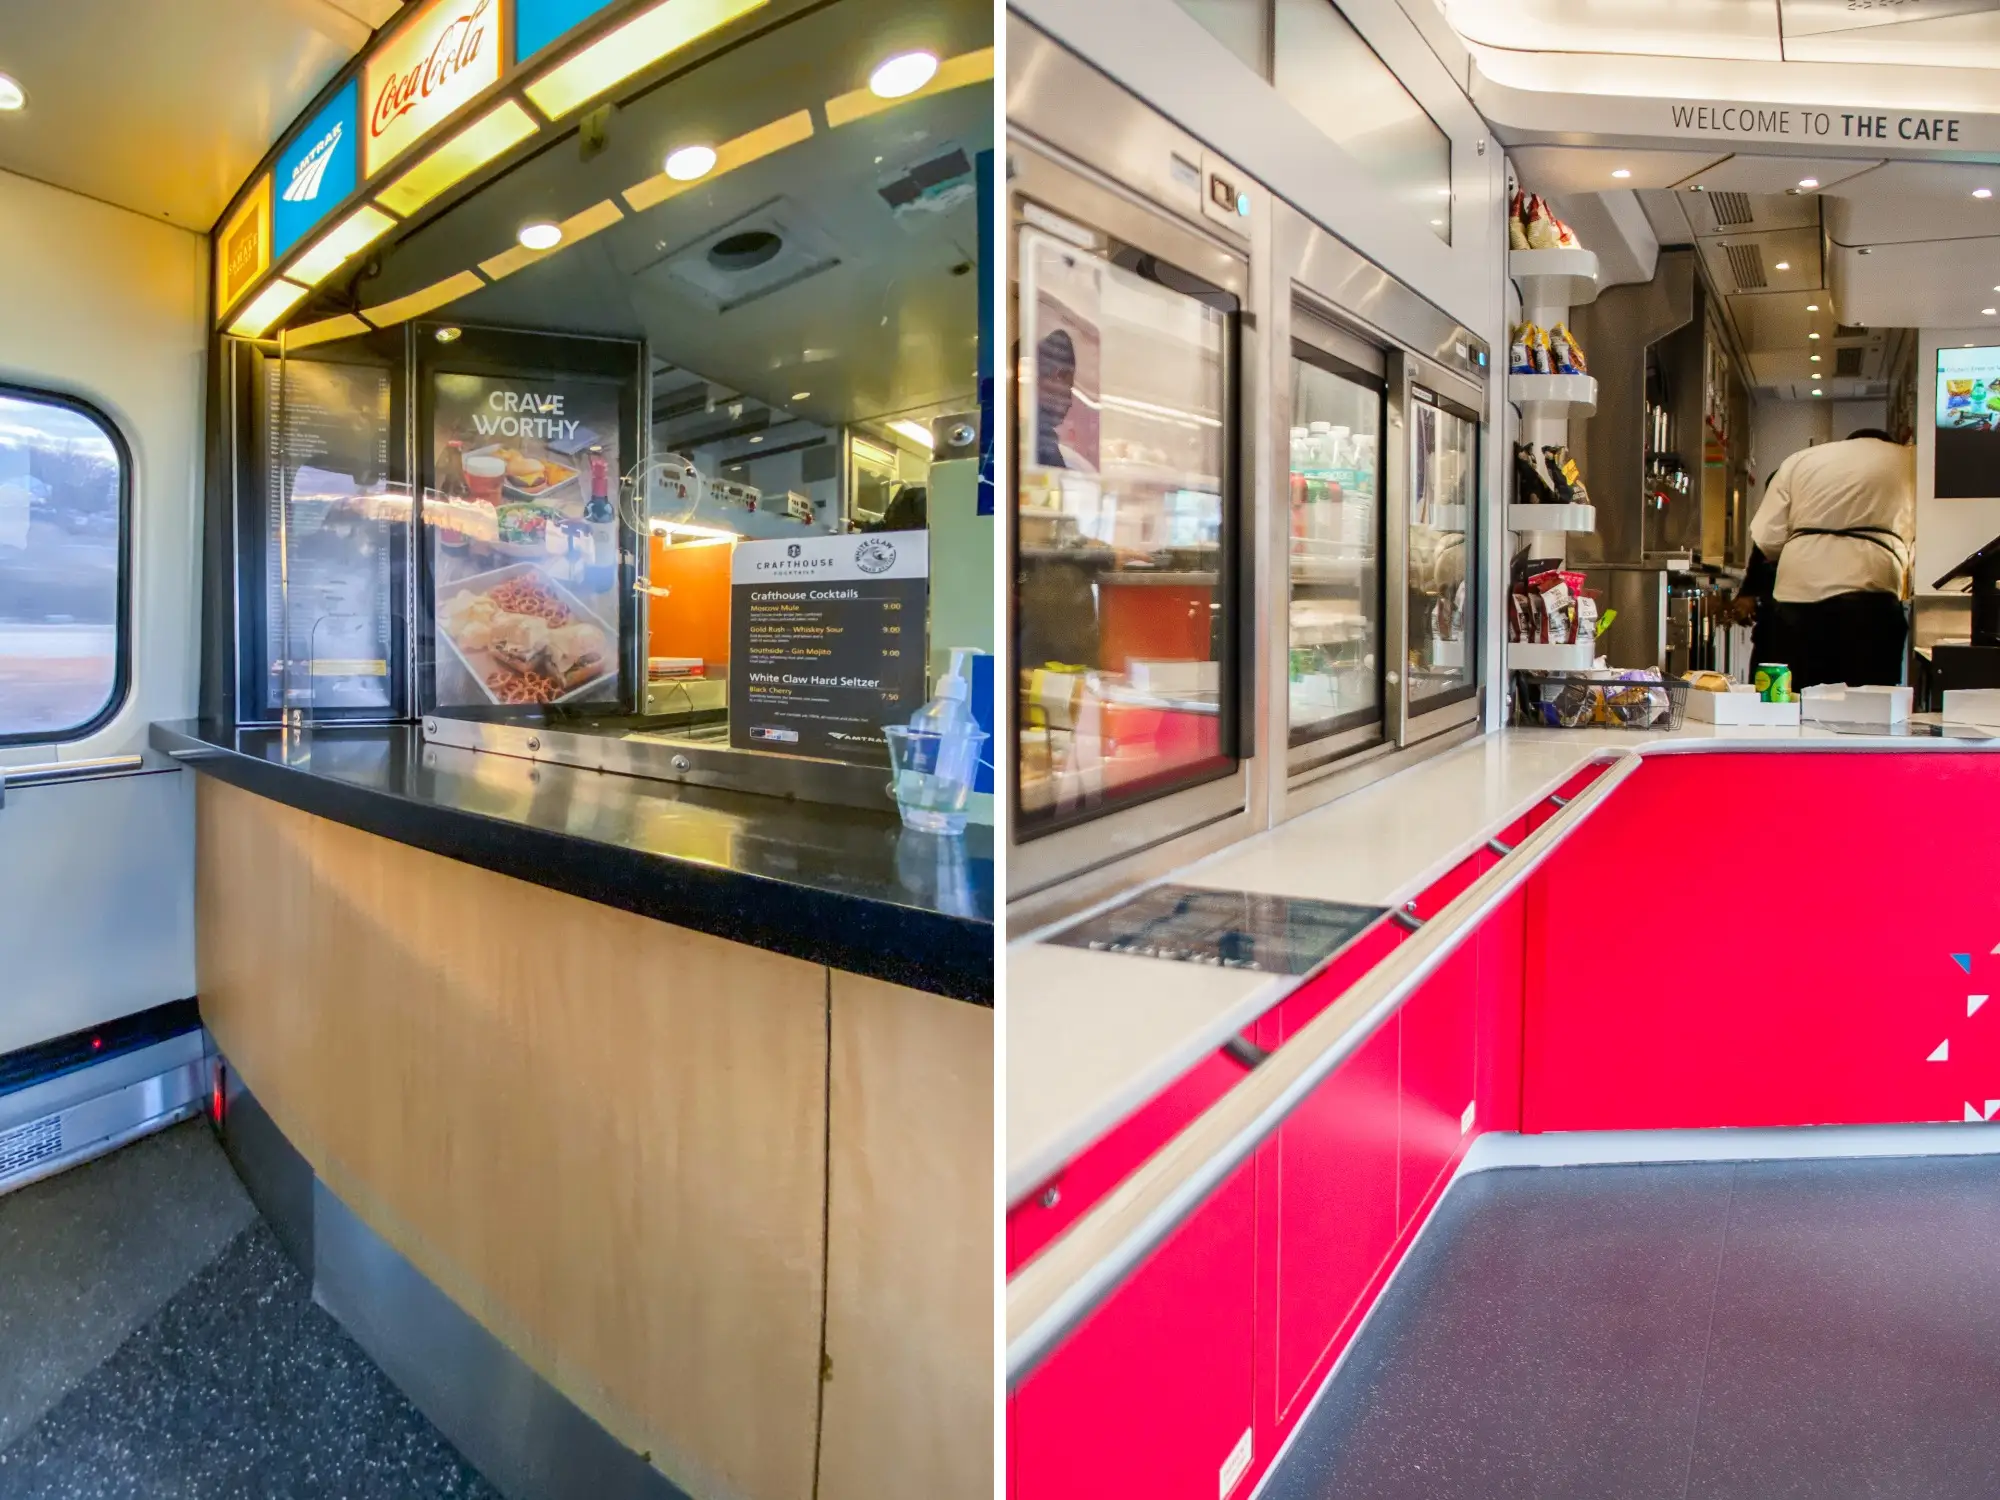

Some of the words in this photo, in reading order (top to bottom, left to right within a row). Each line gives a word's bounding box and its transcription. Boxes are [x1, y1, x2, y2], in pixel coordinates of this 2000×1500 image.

[1671, 105, 1790, 134] WELCOME
[1801, 112, 1830, 135] TO
[1841, 114, 1887, 138] THE
[1898, 117, 1960, 142] CAFE
[291, 120, 344, 180] AMTRAK
[489, 391, 565, 415] CRAVE
[472, 414, 580, 440] WORTHY
[870, 538, 894, 549] CLAW
[756, 558, 834, 570] CRAFTHOUSE
[751, 590, 807, 601] Crafthouse
[809, 589, 859, 599] Cocktails
[883, 602, 901, 610] 9.00
[792, 626, 824, 634] Whiskey
[882, 626, 900, 634] 9.00
[791, 647, 804, 655] Gin
[882, 649, 900, 657] 9.00
[749, 673, 779, 683] White
[782, 674, 808, 684] Claw
[811, 676, 838, 686] Hard
[840, 677, 880, 687] Seltzer
[769, 687, 792, 695] Cherry
[880, 693, 899, 701] 7.50
